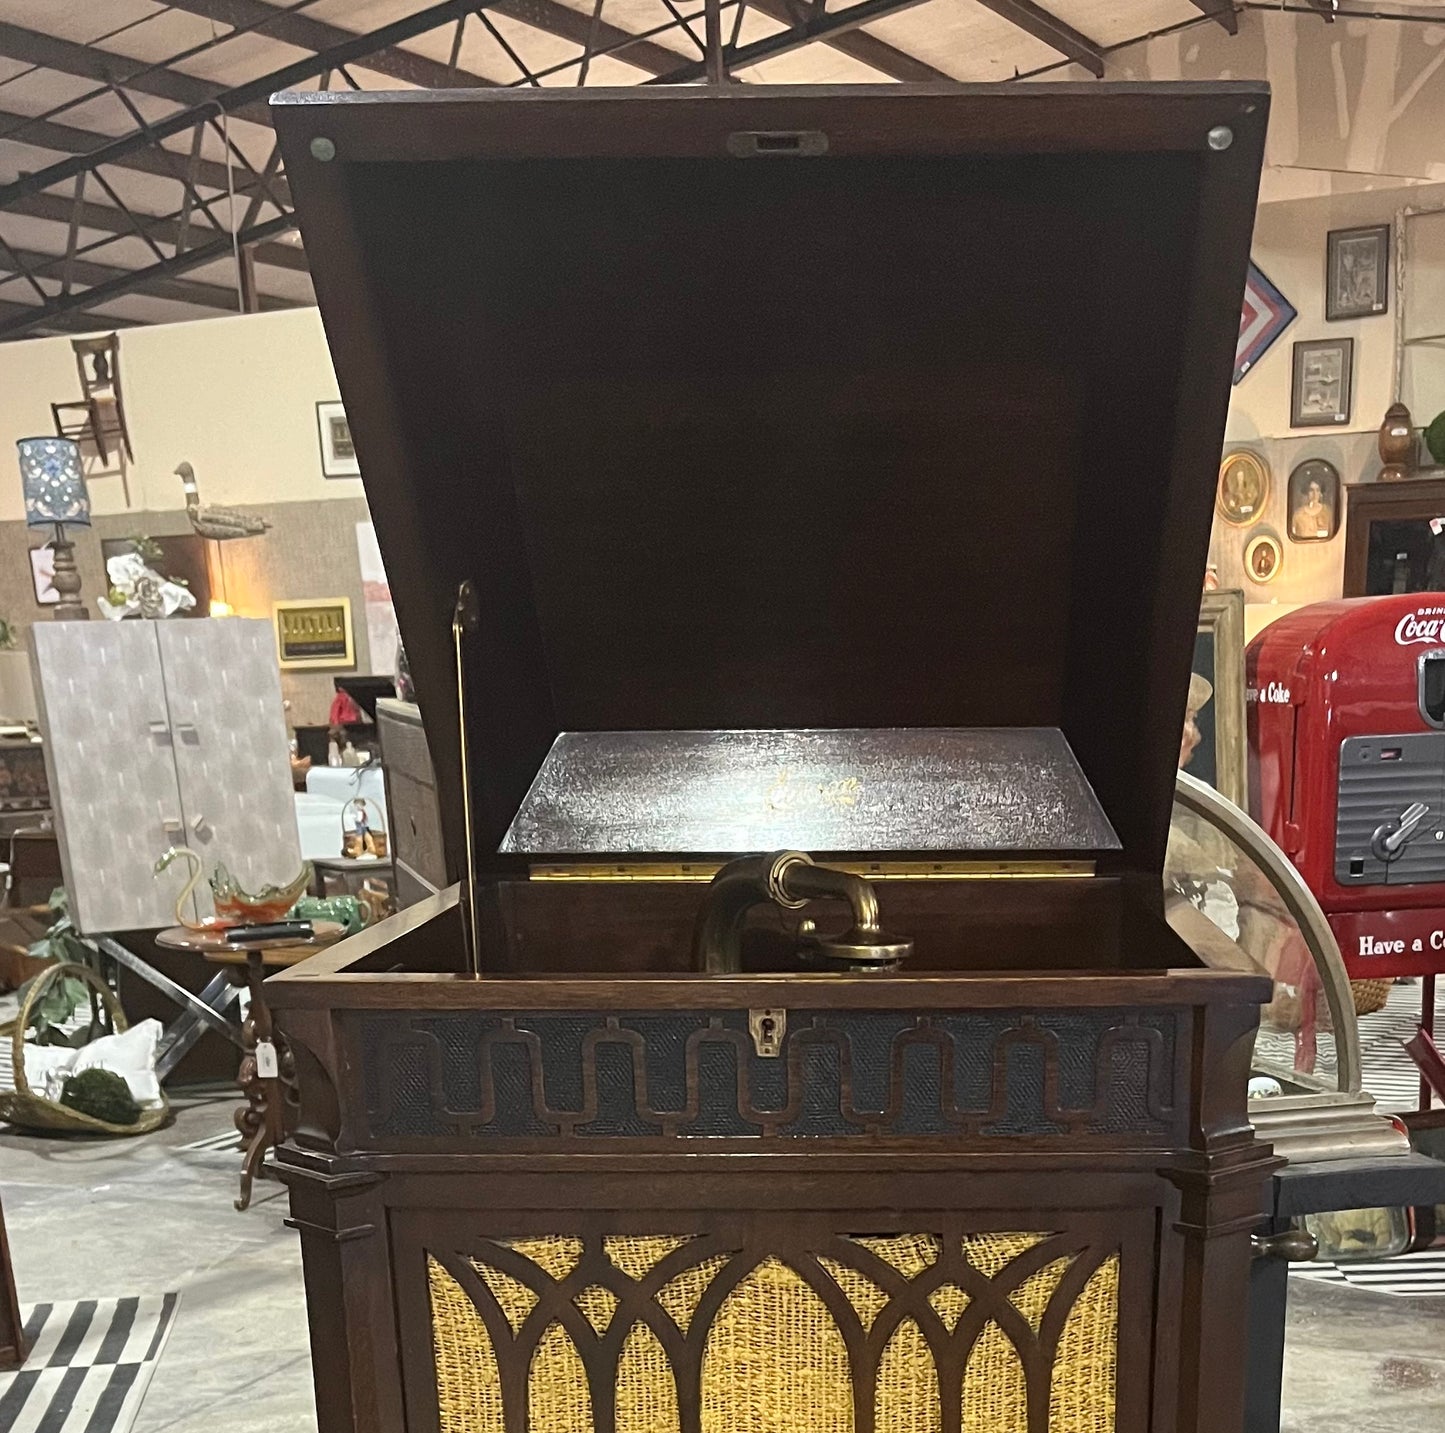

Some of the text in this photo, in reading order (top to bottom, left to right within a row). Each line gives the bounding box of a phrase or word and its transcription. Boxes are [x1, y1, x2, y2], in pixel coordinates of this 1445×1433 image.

[1260, 688, 1266, 703] a
[1268, 681, 1290, 703] Coke
[1359, 935, 1405, 956] Have
[1411, 938, 1423, 952] a
